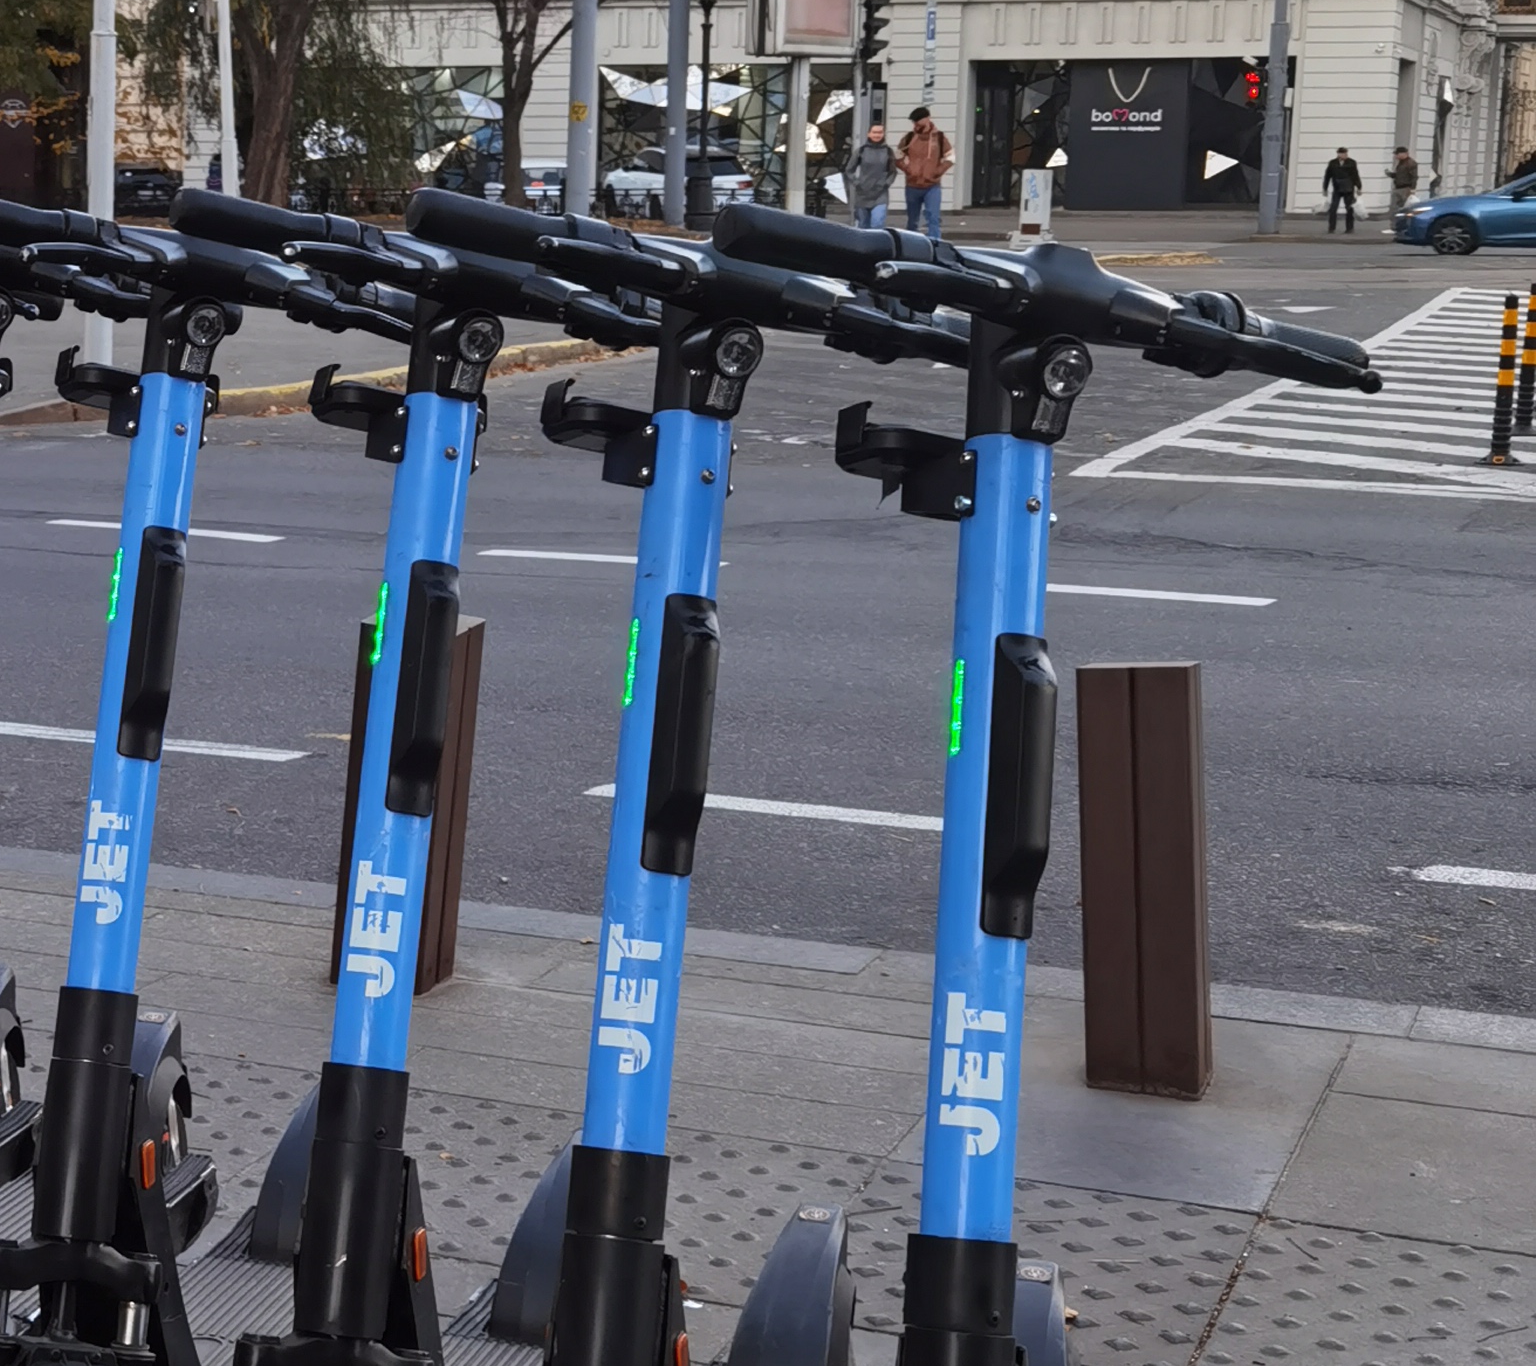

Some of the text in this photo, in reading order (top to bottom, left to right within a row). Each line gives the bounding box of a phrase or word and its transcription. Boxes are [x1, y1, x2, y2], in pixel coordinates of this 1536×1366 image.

[80, 800, 133, 924] JET
[346, 860, 406, 999] JET
[597, 923, 663, 1075] JET
[939, 991, 1007, 1157] JET
